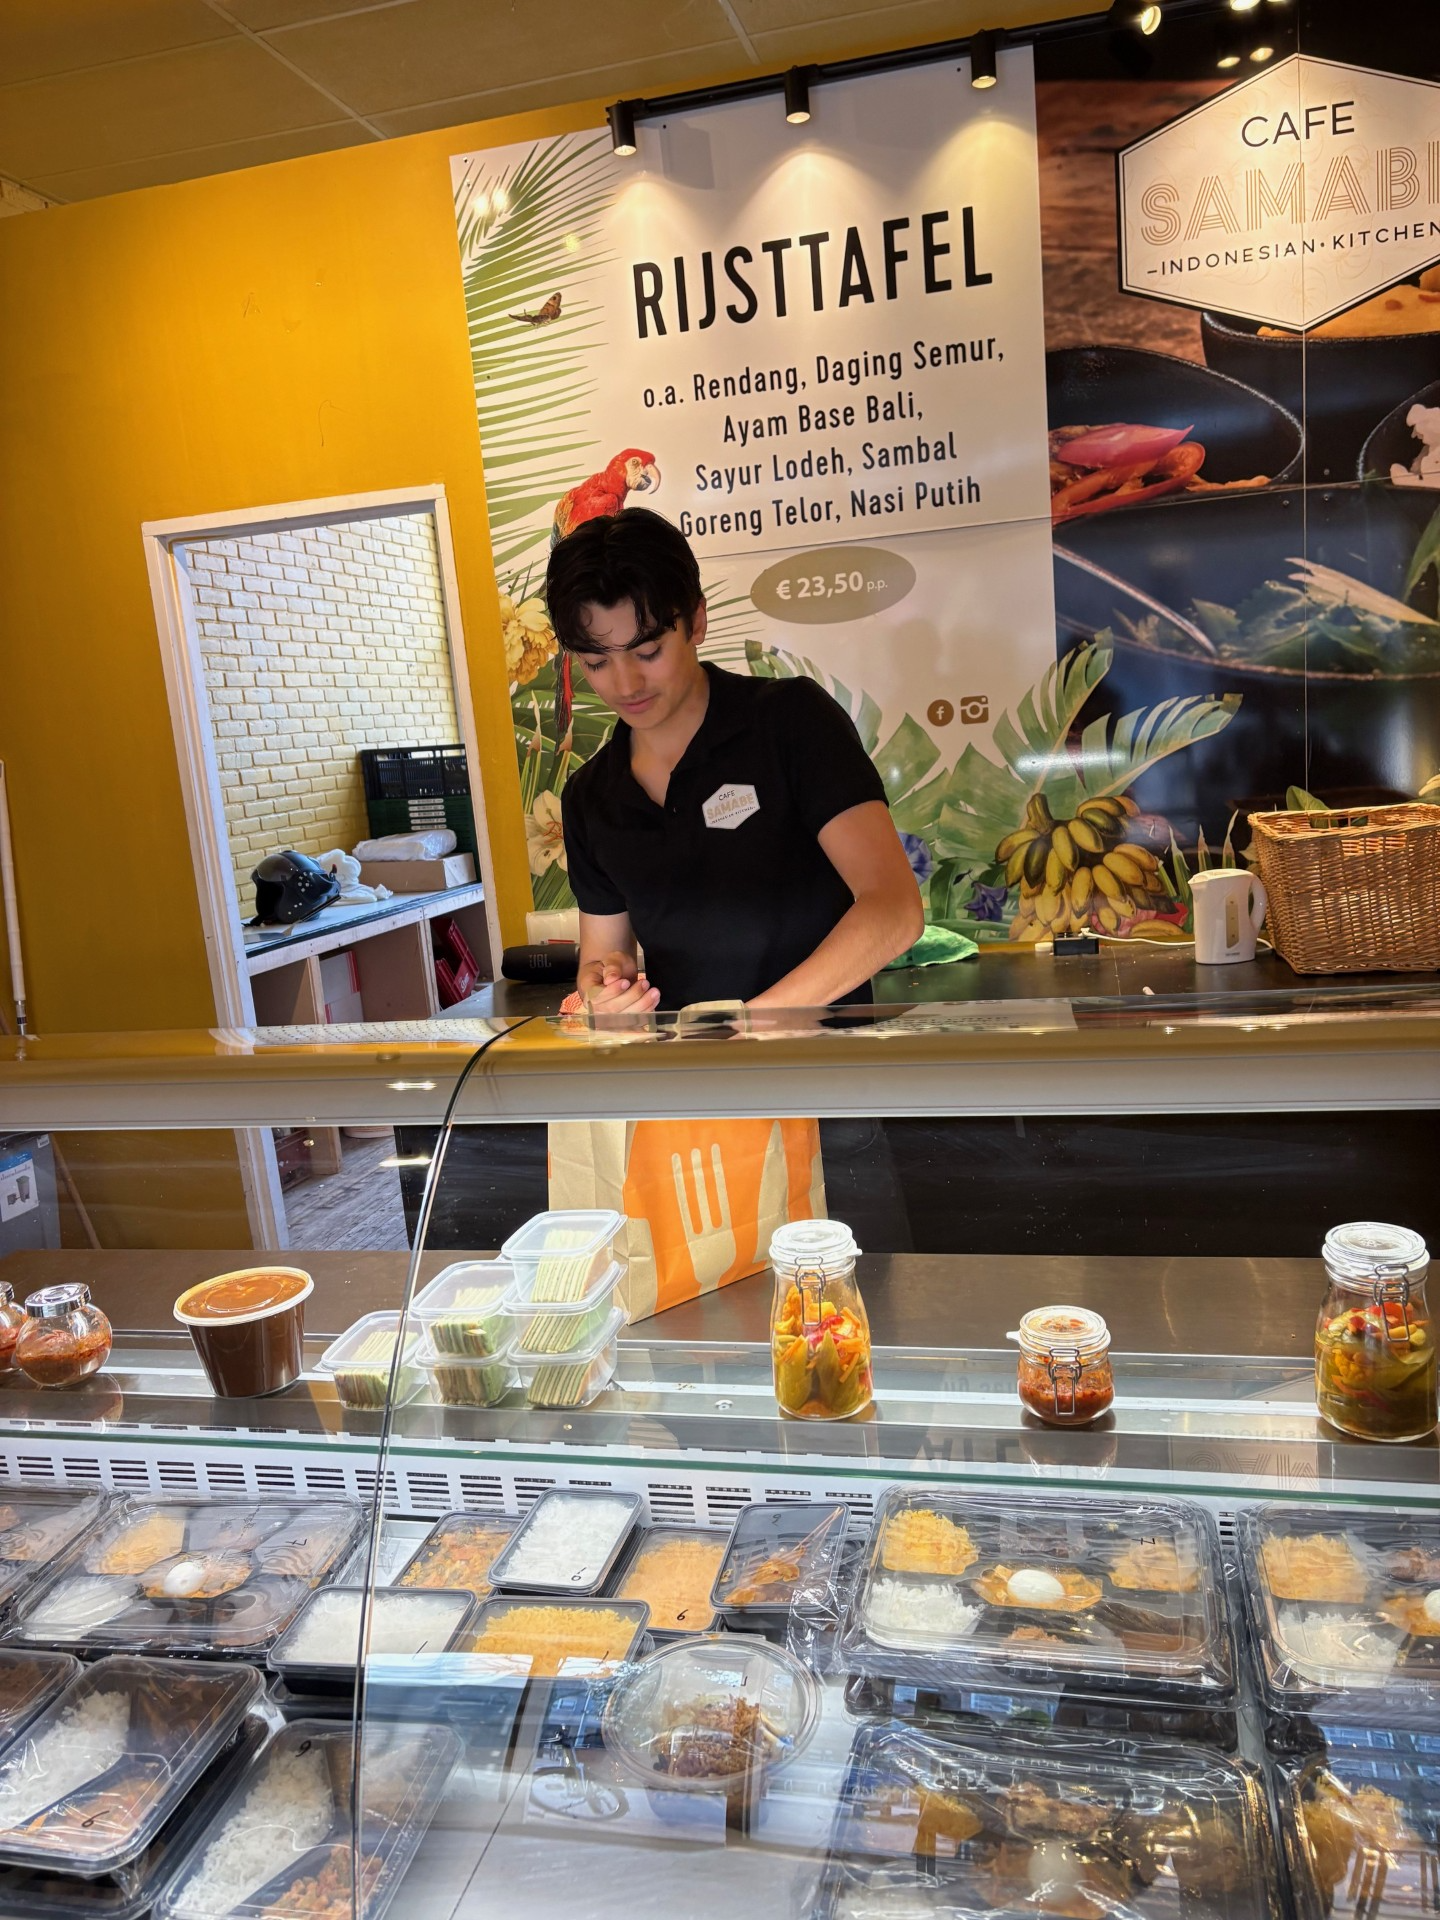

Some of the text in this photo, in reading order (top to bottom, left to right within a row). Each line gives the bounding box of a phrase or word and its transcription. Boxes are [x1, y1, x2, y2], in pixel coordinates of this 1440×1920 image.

[1241, 100, 1355, 147] CAFE
[632, 206, 993, 339] RIJSTTAFEL
[643, 336, 1004, 409] o.a. Rendang, Daging Semur,
[723, 390, 923, 447] Ayam Base Bali,
[695, 432, 957, 494] Sayur Lodeh, Sambal
[680, 476, 982, 538] Goreng Telor, Nasi Putih
[796, 571, 863, 598] 23,50
[706, 793, 755, 820] SAMABE
[718, 789, 736, 801] CAFE
[529, 953, 552, 969] JBL
